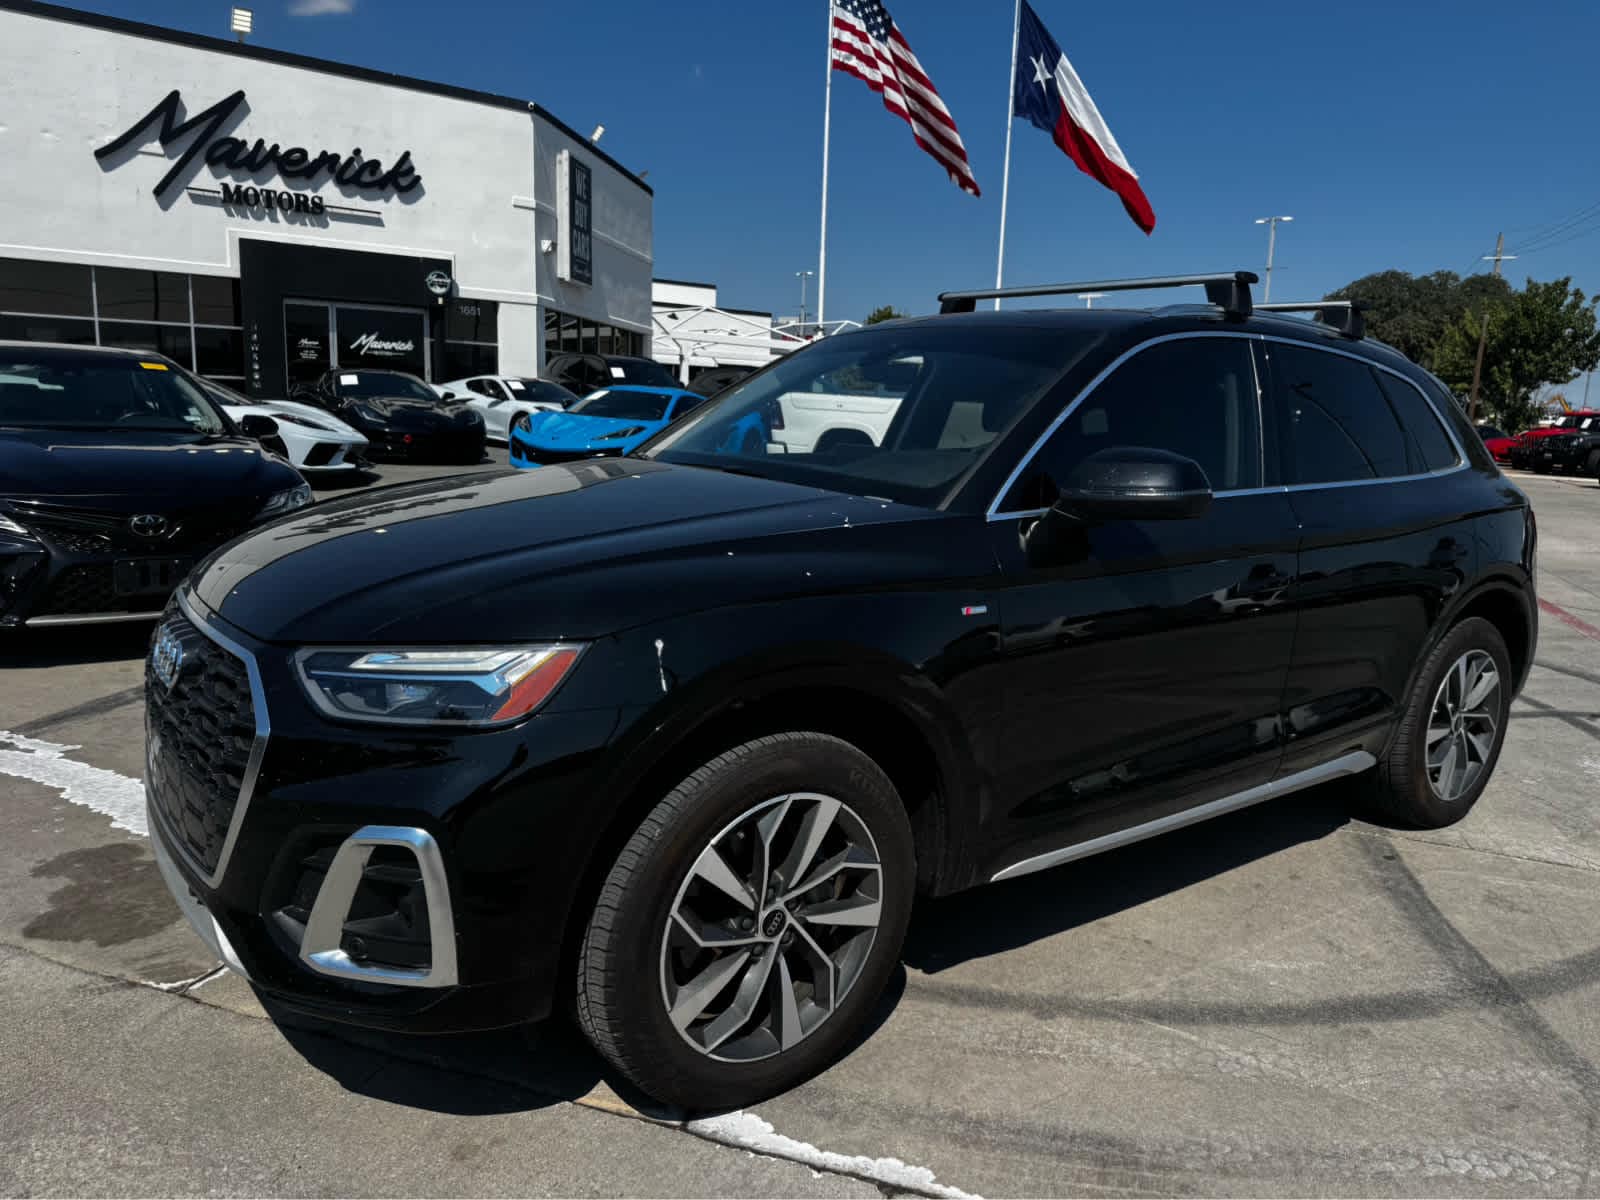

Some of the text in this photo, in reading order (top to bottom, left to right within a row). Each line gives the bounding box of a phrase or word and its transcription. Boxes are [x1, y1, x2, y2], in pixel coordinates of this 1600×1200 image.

[94, 89, 421, 198] Maverick
[219, 182, 325, 215] MOTORS
[575, 167, 589, 200] WE
[350, 331, 415, 356] Maverick
